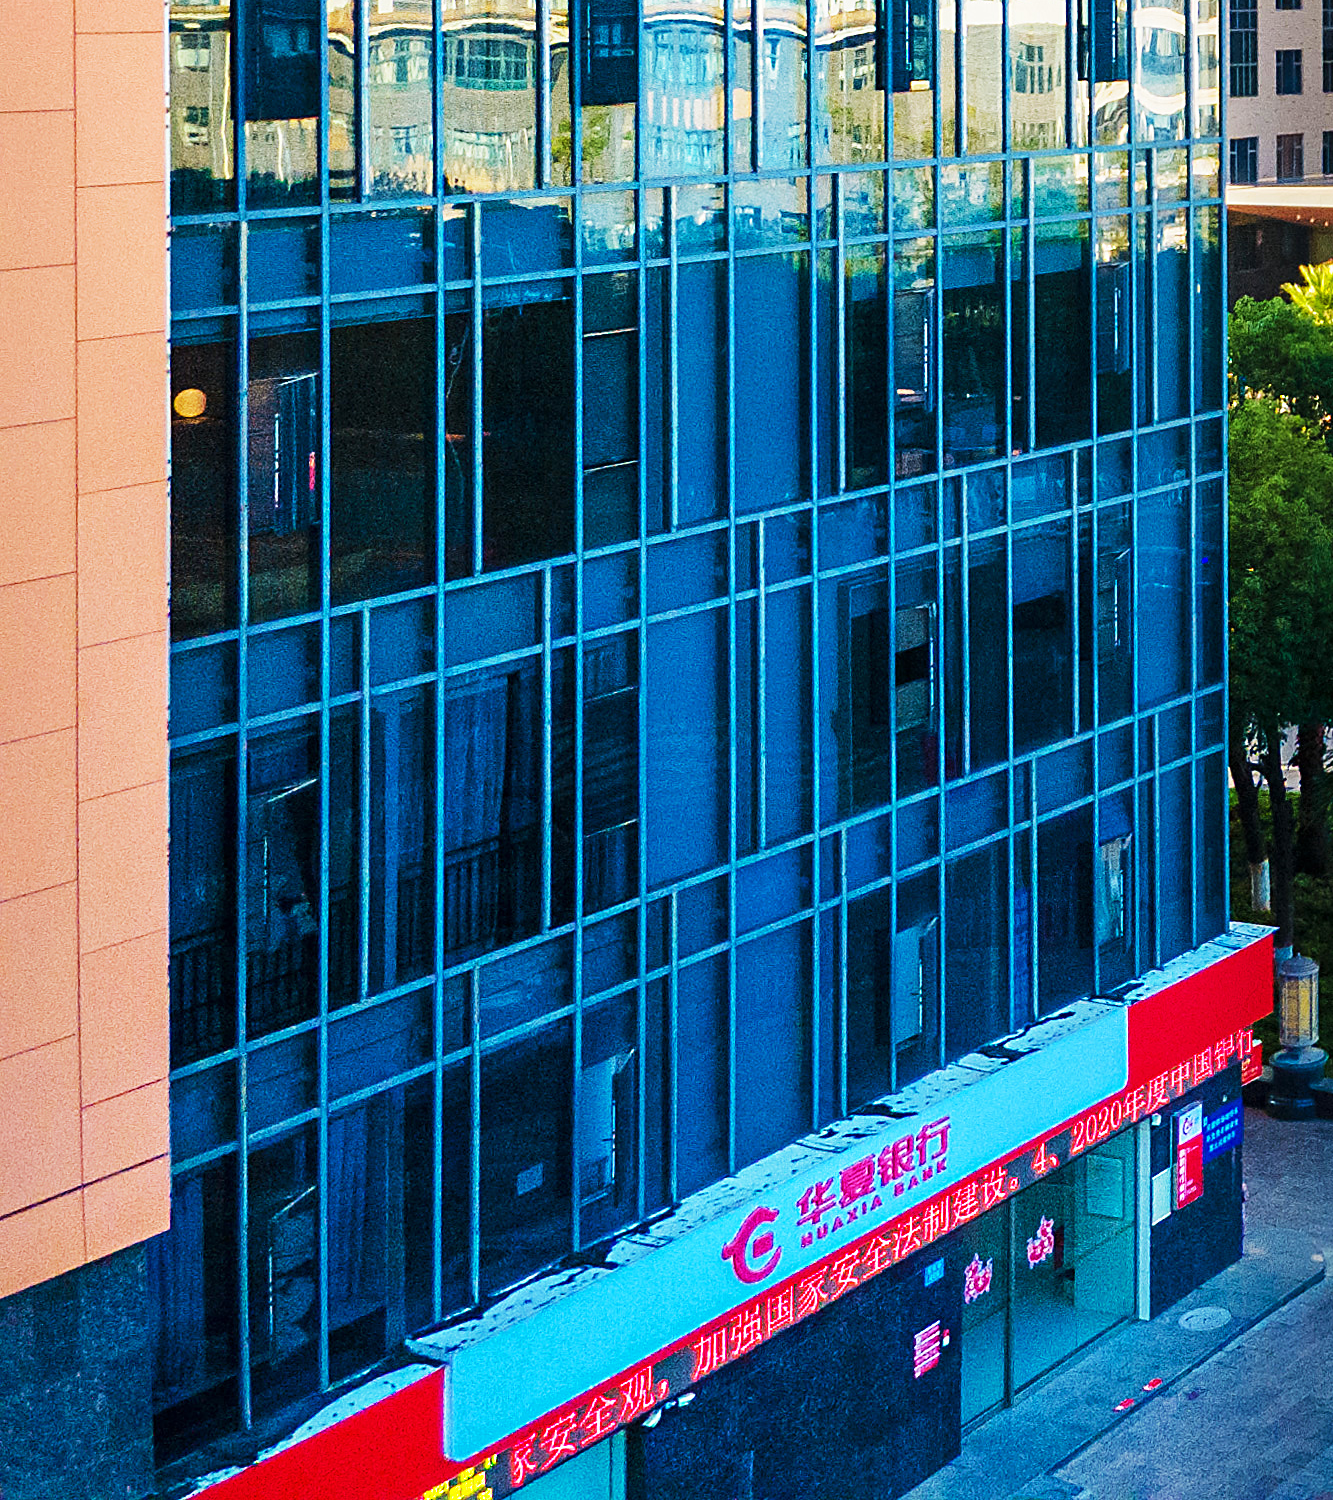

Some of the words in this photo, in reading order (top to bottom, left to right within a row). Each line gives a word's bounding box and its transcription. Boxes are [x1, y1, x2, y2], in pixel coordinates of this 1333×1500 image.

[796, 1115, 952, 1227] 华夏银行
[800, 1195, 883, 1248] HUAXIA
[893, 1157, 948, 1198] BANK
